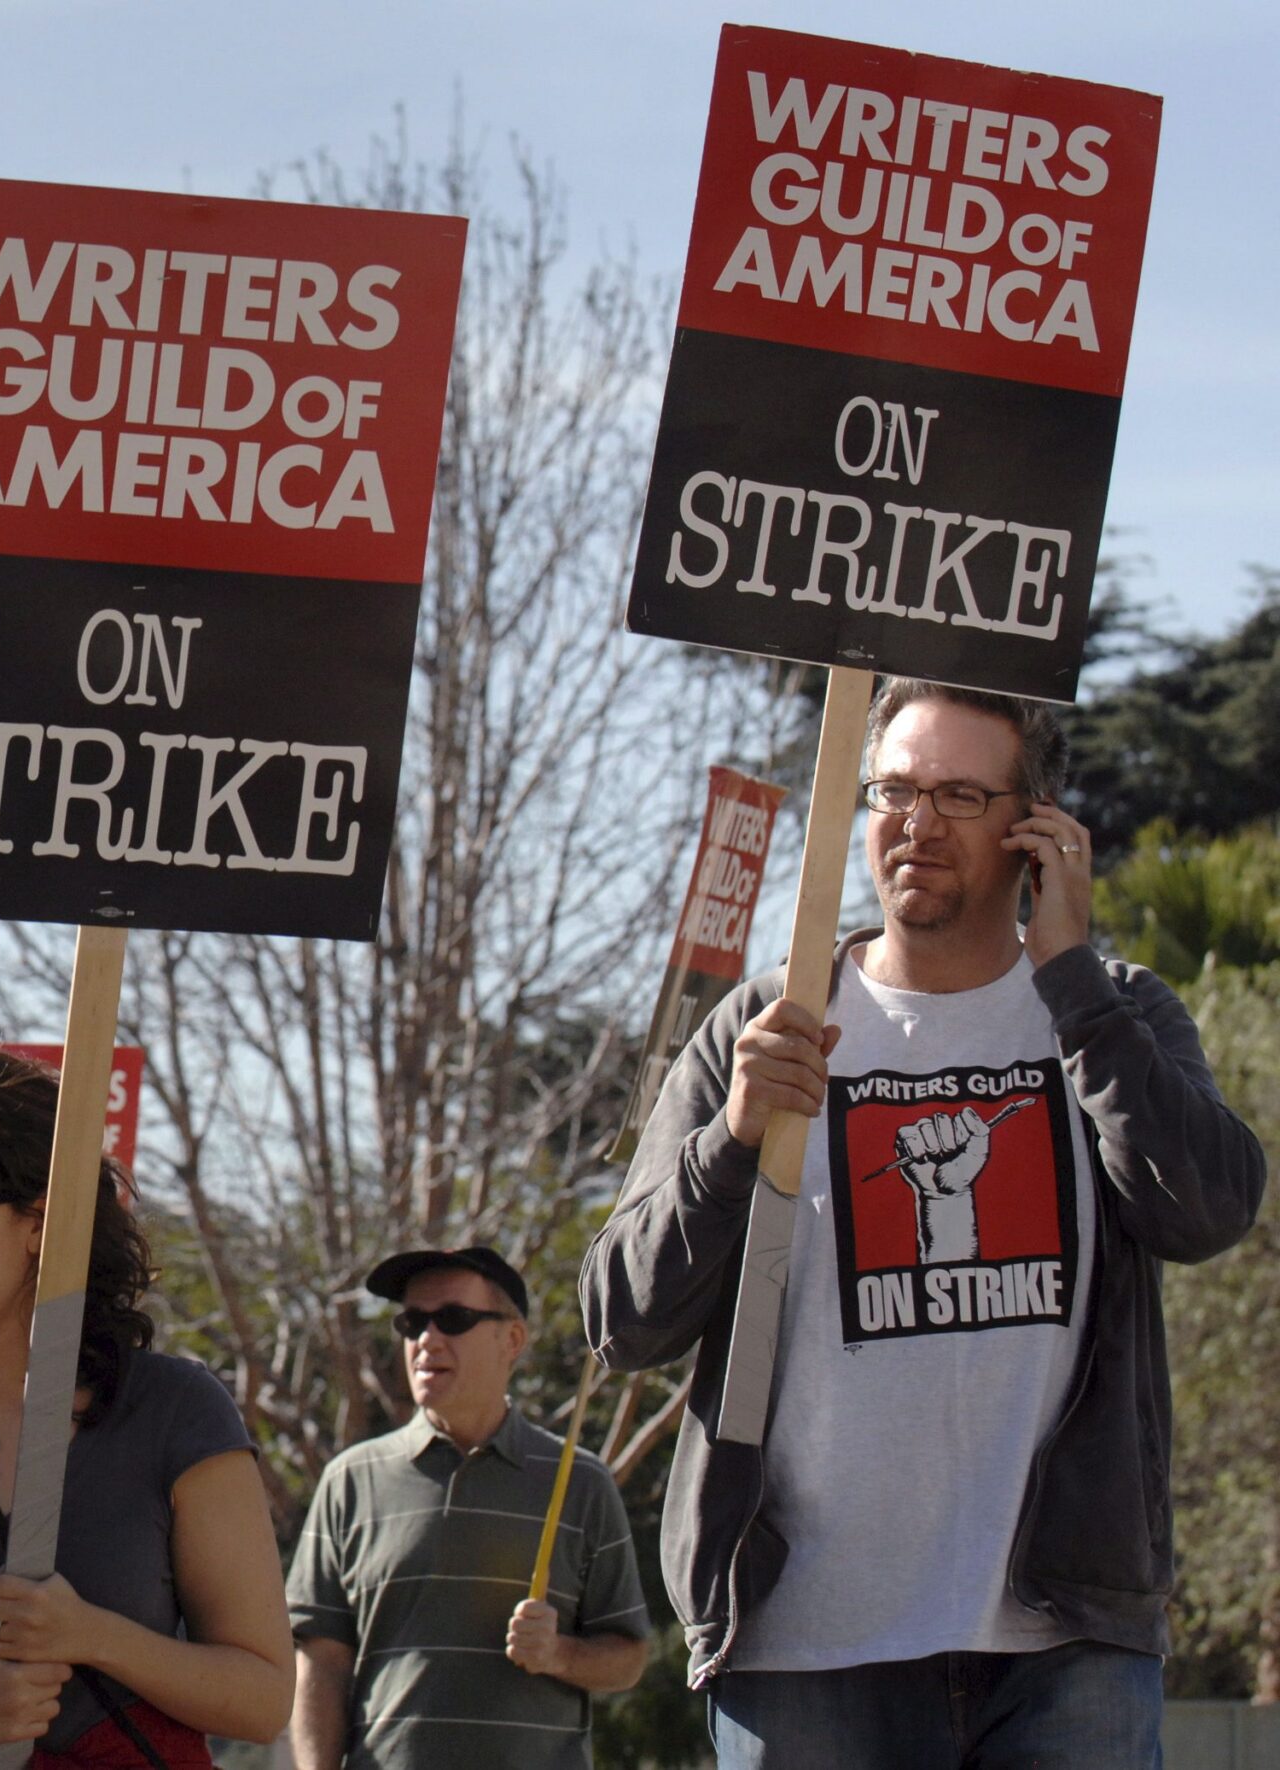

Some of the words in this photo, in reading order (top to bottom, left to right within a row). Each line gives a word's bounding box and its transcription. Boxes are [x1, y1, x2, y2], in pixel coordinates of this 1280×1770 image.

[747, 71, 1111, 197] WRITERS
[750, 152, 1005, 254] GUILD
[1009, 214, 1093, 271] OF
[714, 228, 1099, 353] AMERICA
[281, 377, 381, 440] OF
[834, 395, 939, 485] ON
[666, 470, 1071, 641] STRIKE
[76, 608, 203, 709] ON
[847, 1075, 959, 1103] WRITERS
[967, 1068, 1044, 1096] GUILD
[857, 1272, 915, 1332] ON
[925, 1262, 1062, 1326] STRIKE
